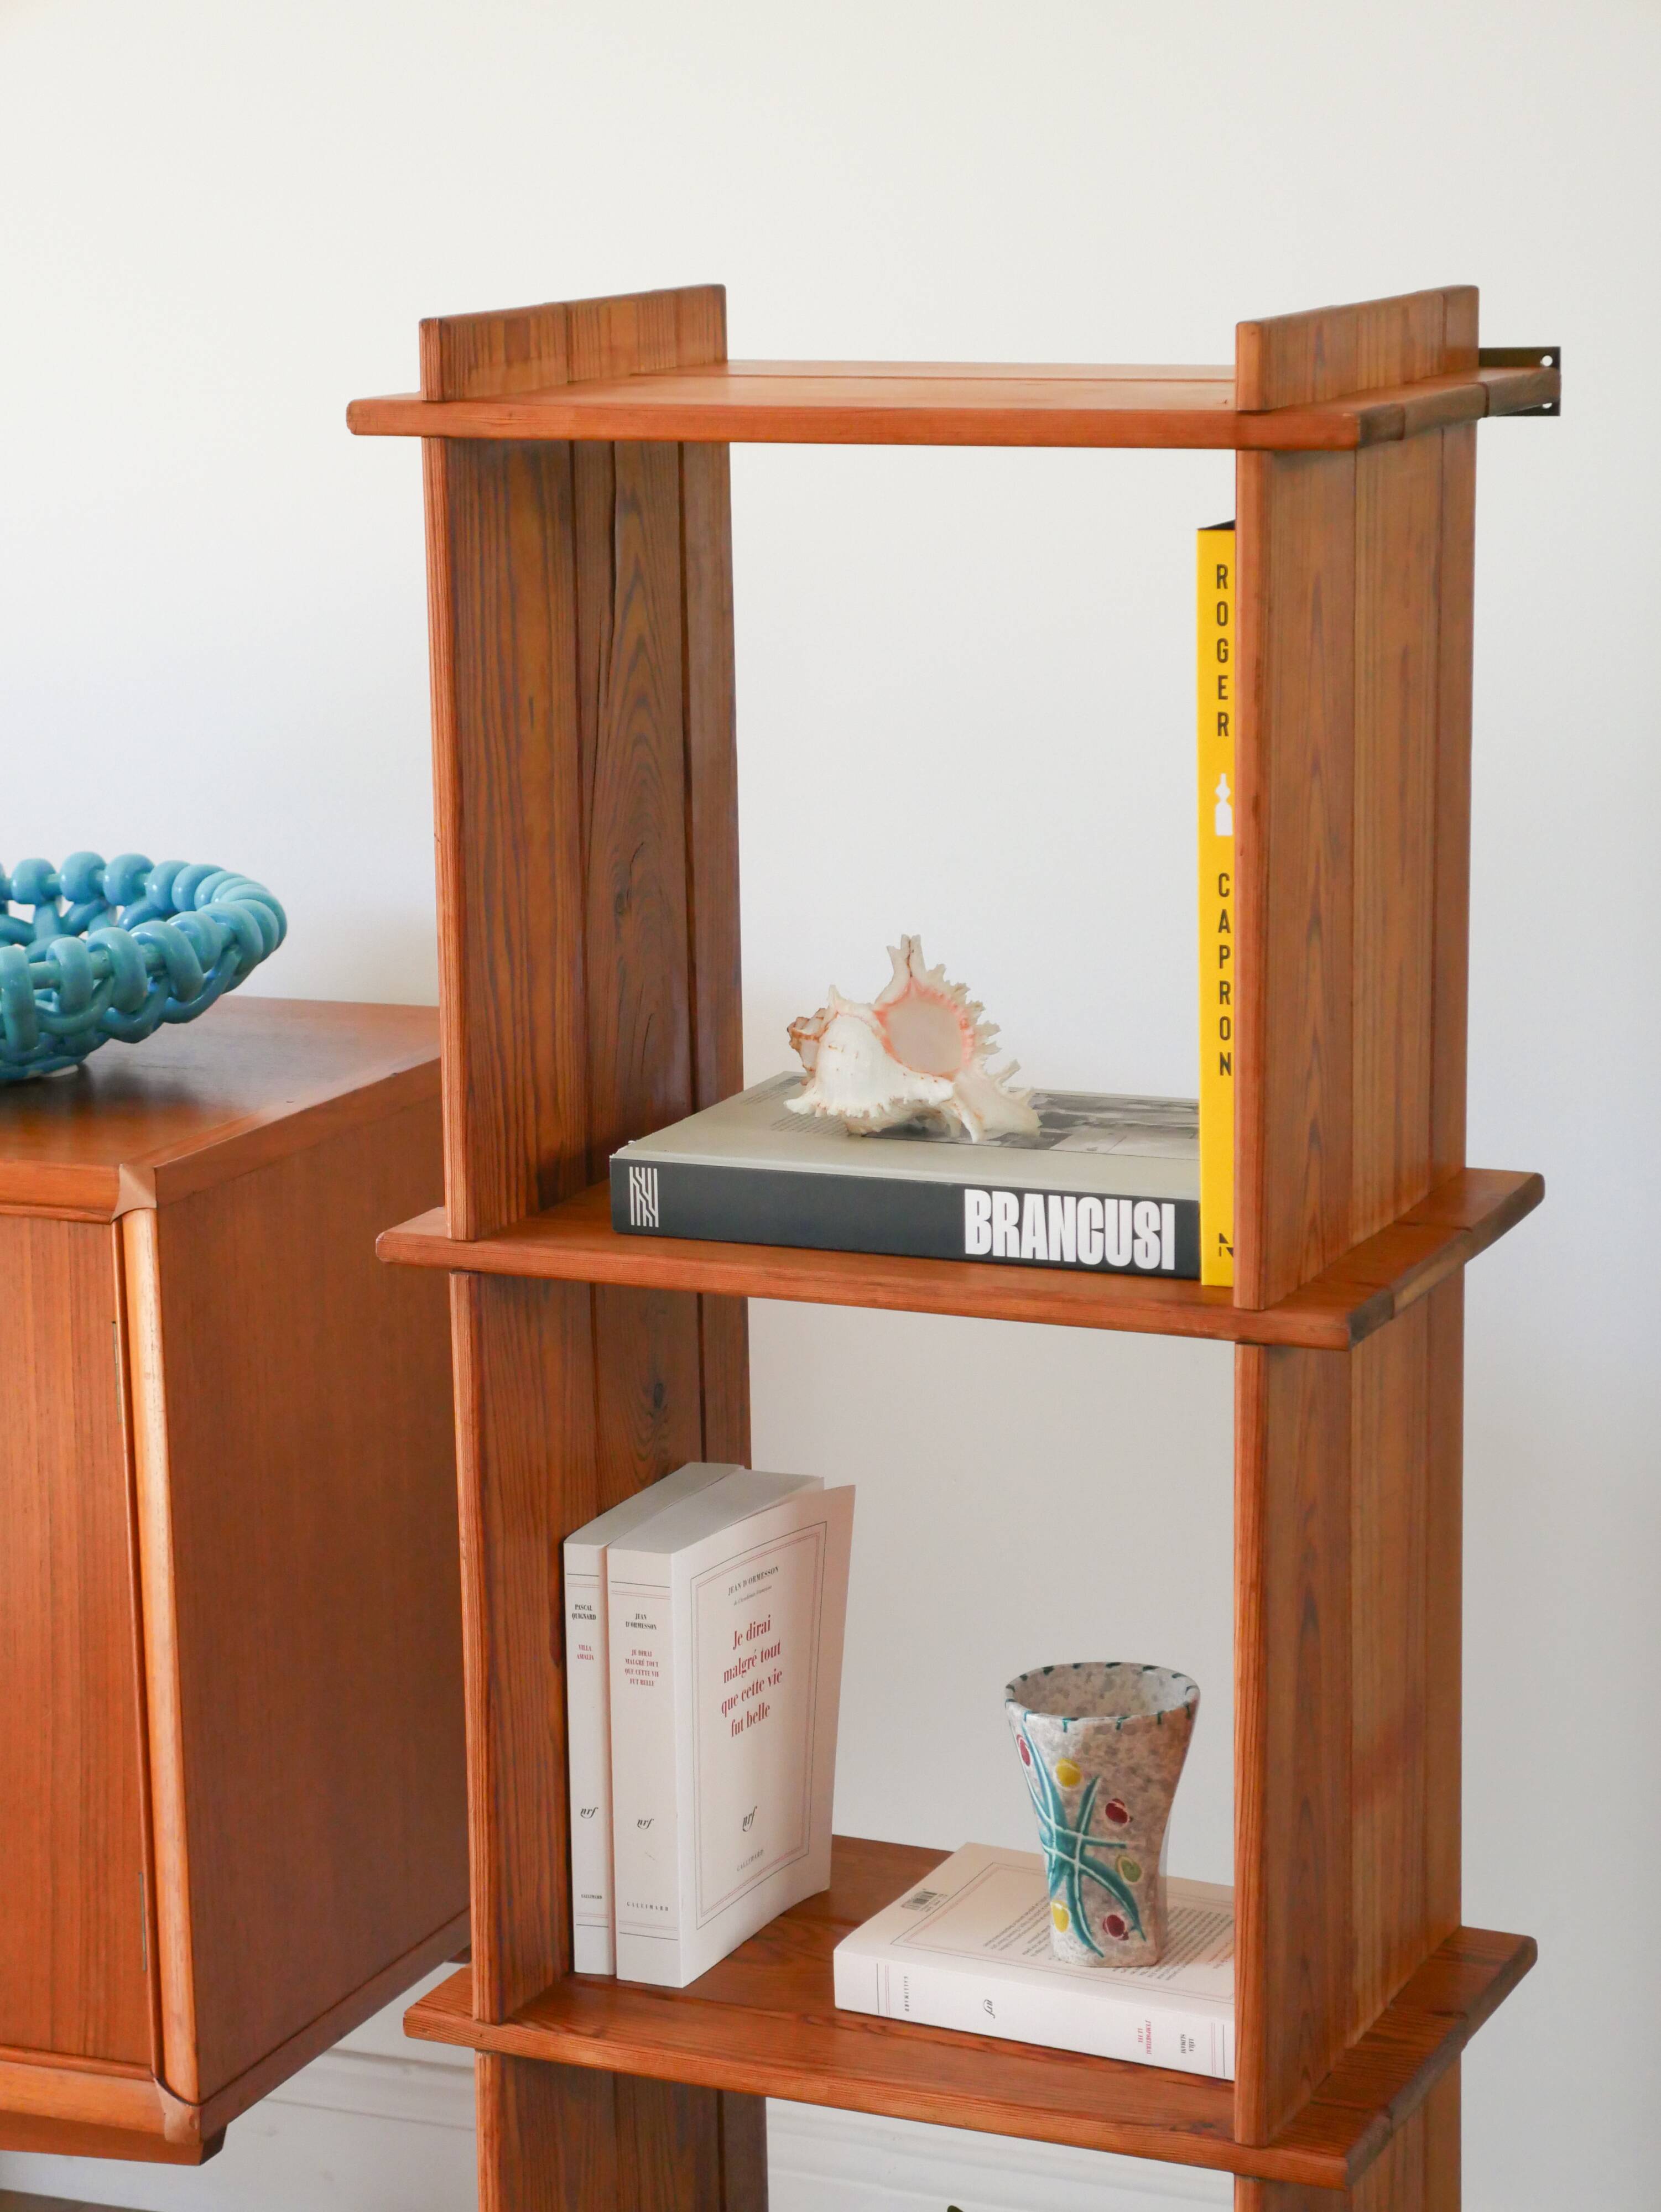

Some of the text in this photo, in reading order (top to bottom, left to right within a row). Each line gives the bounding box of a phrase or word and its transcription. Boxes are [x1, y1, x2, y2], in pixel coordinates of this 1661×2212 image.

[1216, 564, 1232, 1076] ROGER CAPRON
[964, 1188, 1175, 1271] BRANCUSI
[728, 1583, 741, 1596] JEAN
[743, 1566, 779, 1588] D'ORMESSON
[625, 1621, 657, 1630] D'ORMESSON
[732, 1614, 771, 1651] Je dirai
[723, 1637, 780, 1684] malgré tout
[721, 1668, 782, 1718] que cette vie
[731, 1702, 770, 1738] fut belle
[580, 1807, 598, 1819] nrf
[637, 1818, 654, 1830] nrf
[742, 1806, 757, 1832] nrf
[627, 1901, 669, 1912] GALLIMARD
[983, 1999, 995, 2019] nrf
